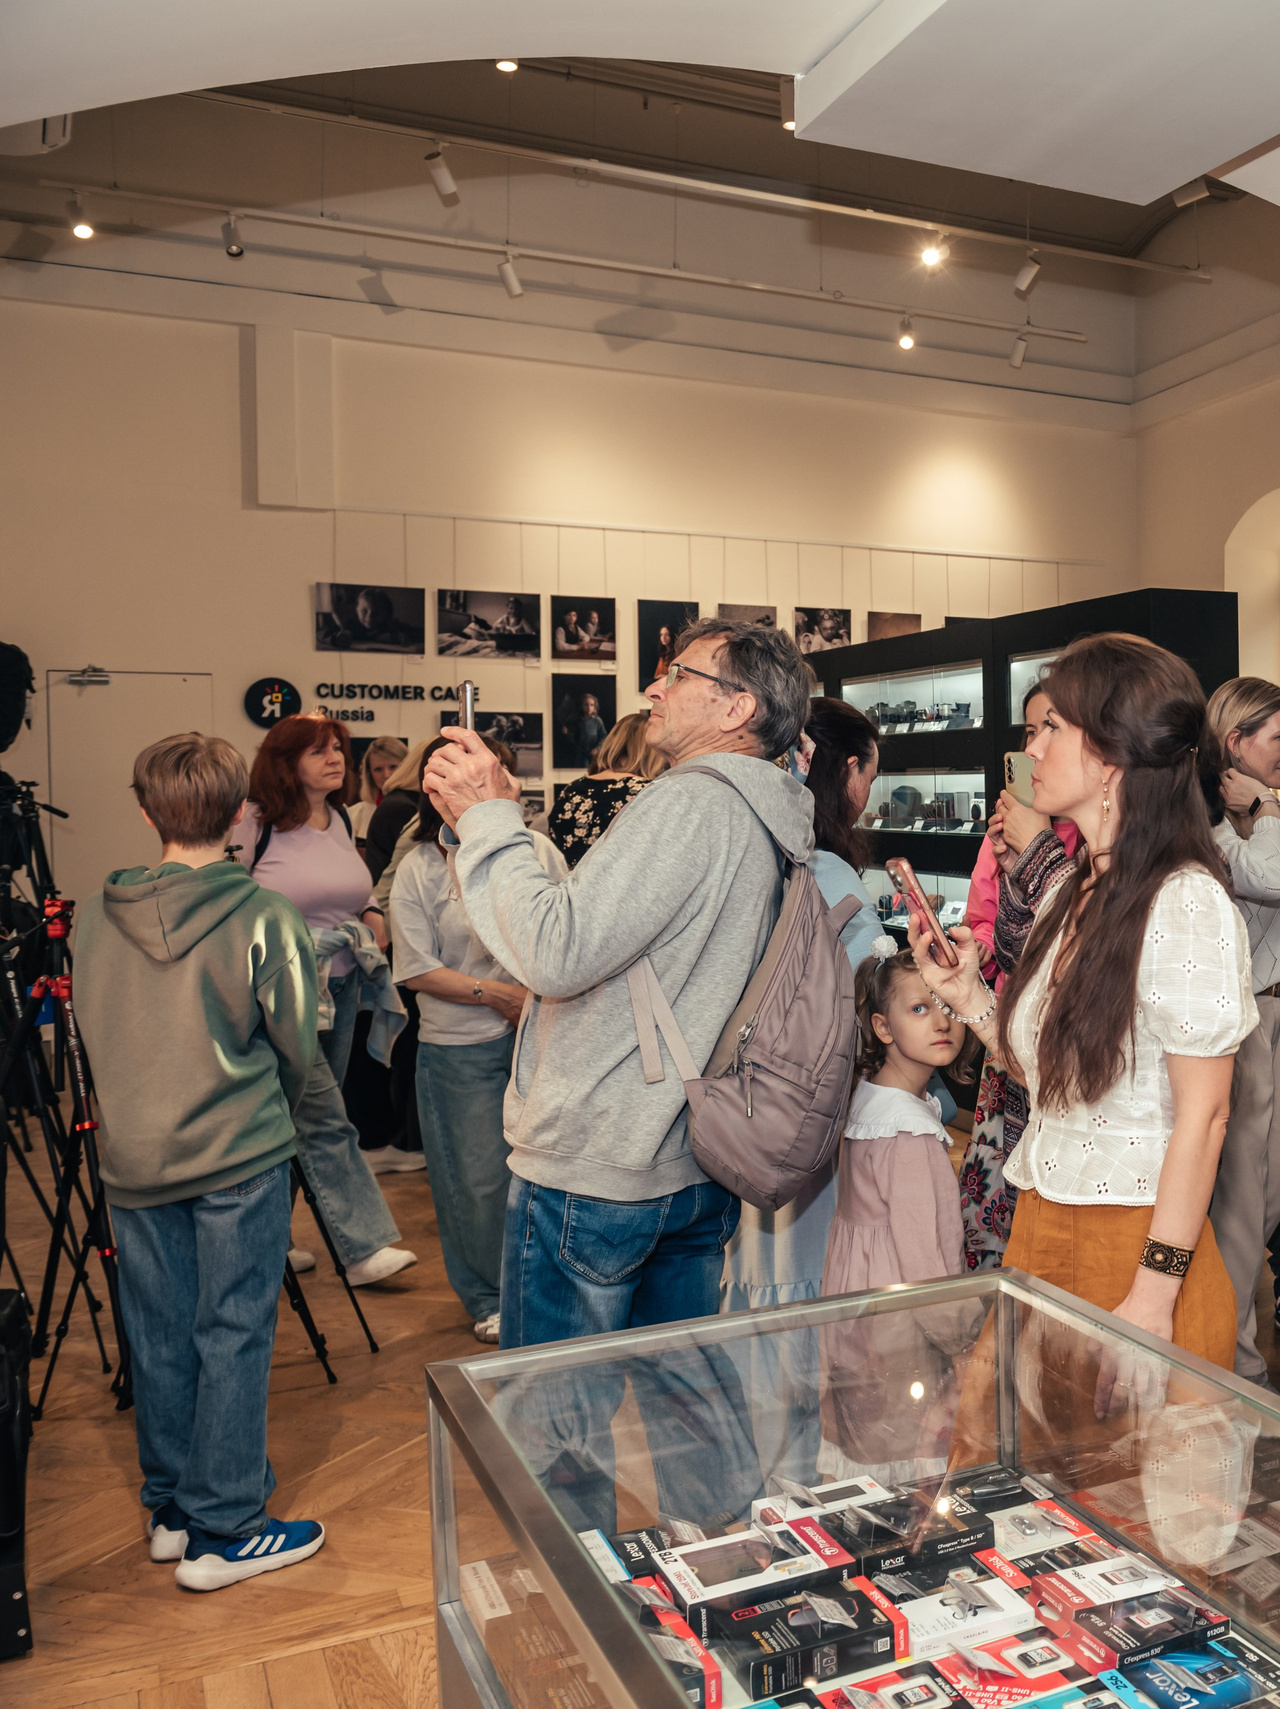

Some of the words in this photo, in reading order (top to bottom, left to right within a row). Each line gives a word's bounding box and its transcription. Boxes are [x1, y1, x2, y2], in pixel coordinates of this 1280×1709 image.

[315, 682, 426, 701] CUSTOMER
[318, 705, 375, 723] Russia
[800, 1525, 829, 1550] Transcend
[624, 1541, 645, 1562] Lexar
[658, 1551, 679, 1565] 2TB
[881, 1554, 906, 1568] Lexar
[988, 1554, 1018, 1579] SanDisk
[1045, 1576, 1076, 1601] Transcend
[868, 1590, 891, 1609] SanDisk
[700, 1607, 708, 1638] Transcend
[1206, 1626, 1226, 1638] 512GB
[1123, 1651, 1151, 1665] CFexpress
[1000, 1686, 1030, 1695] UHS-II
[1144, 1672, 1200, 1709] Lexar
